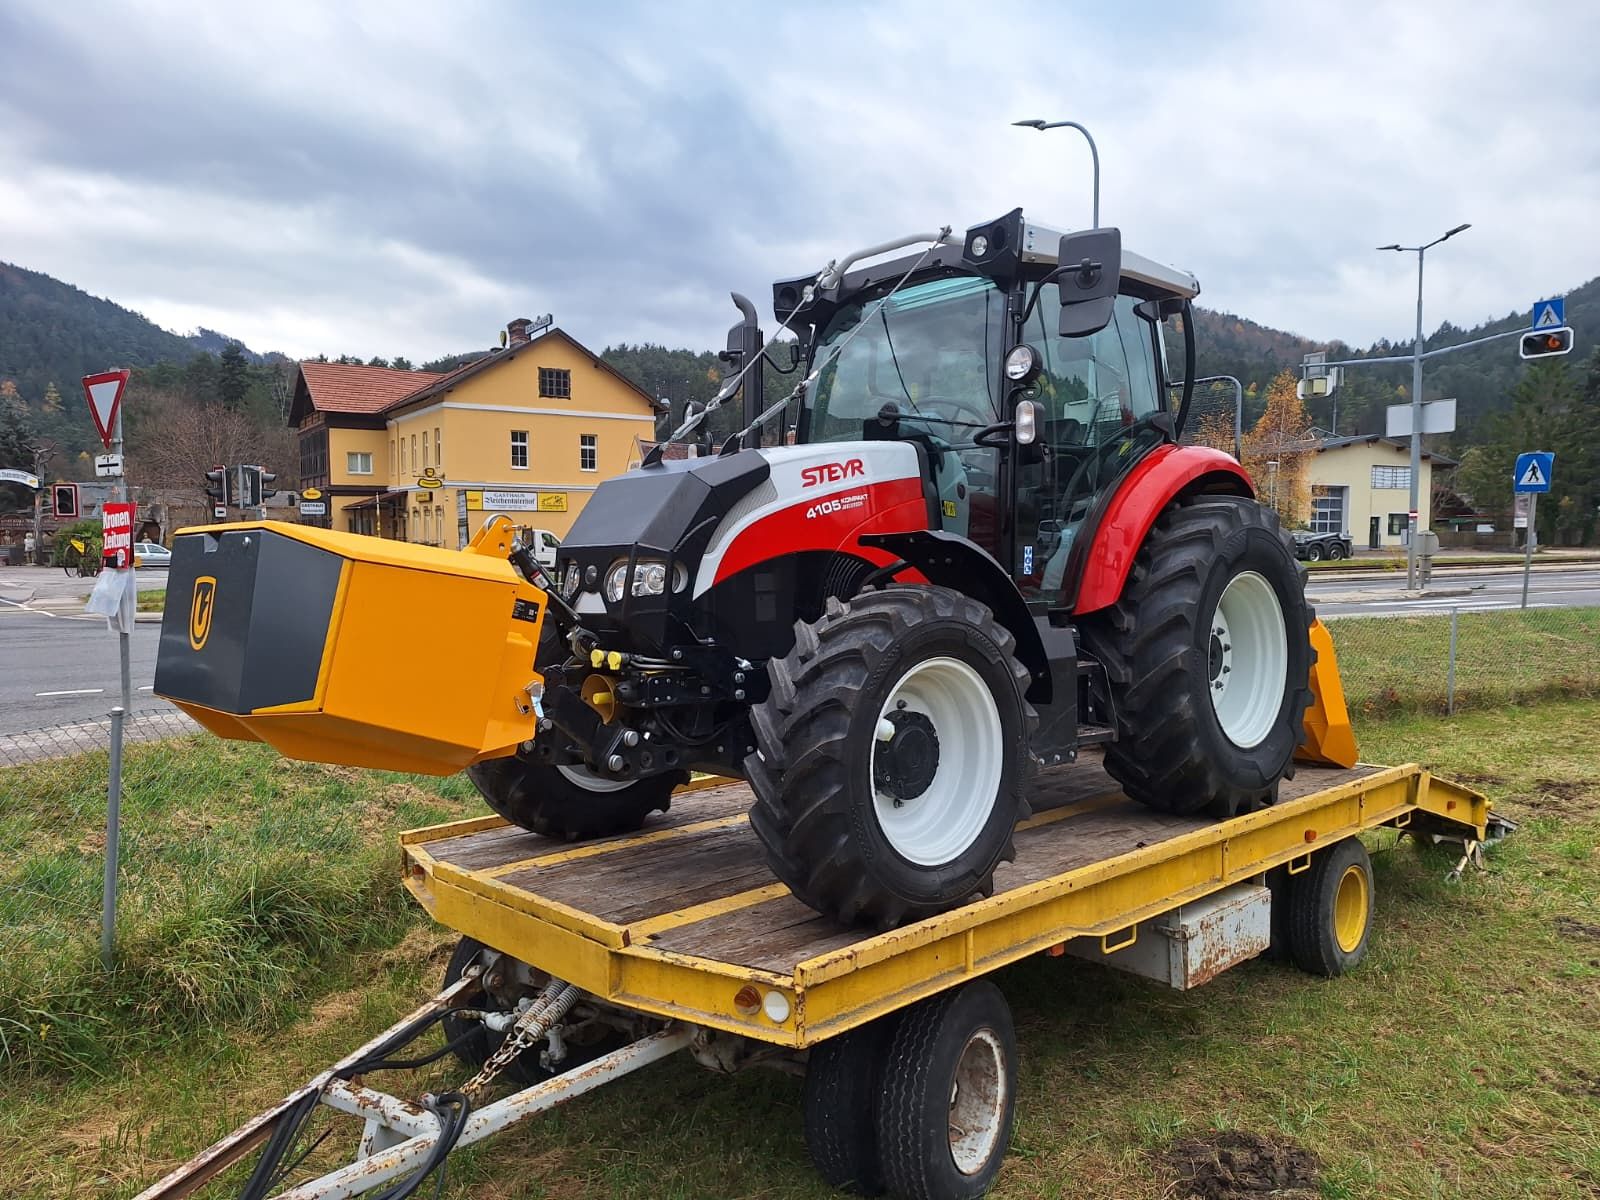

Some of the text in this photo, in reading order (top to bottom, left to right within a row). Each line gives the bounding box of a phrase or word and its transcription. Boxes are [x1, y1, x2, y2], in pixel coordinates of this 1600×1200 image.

[801, 459, 864, 487] STEYR
[806, 500, 841, 519] 4105
[103, 511, 129, 529] Kronen
[103, 531, 130, 549] Zeitung
